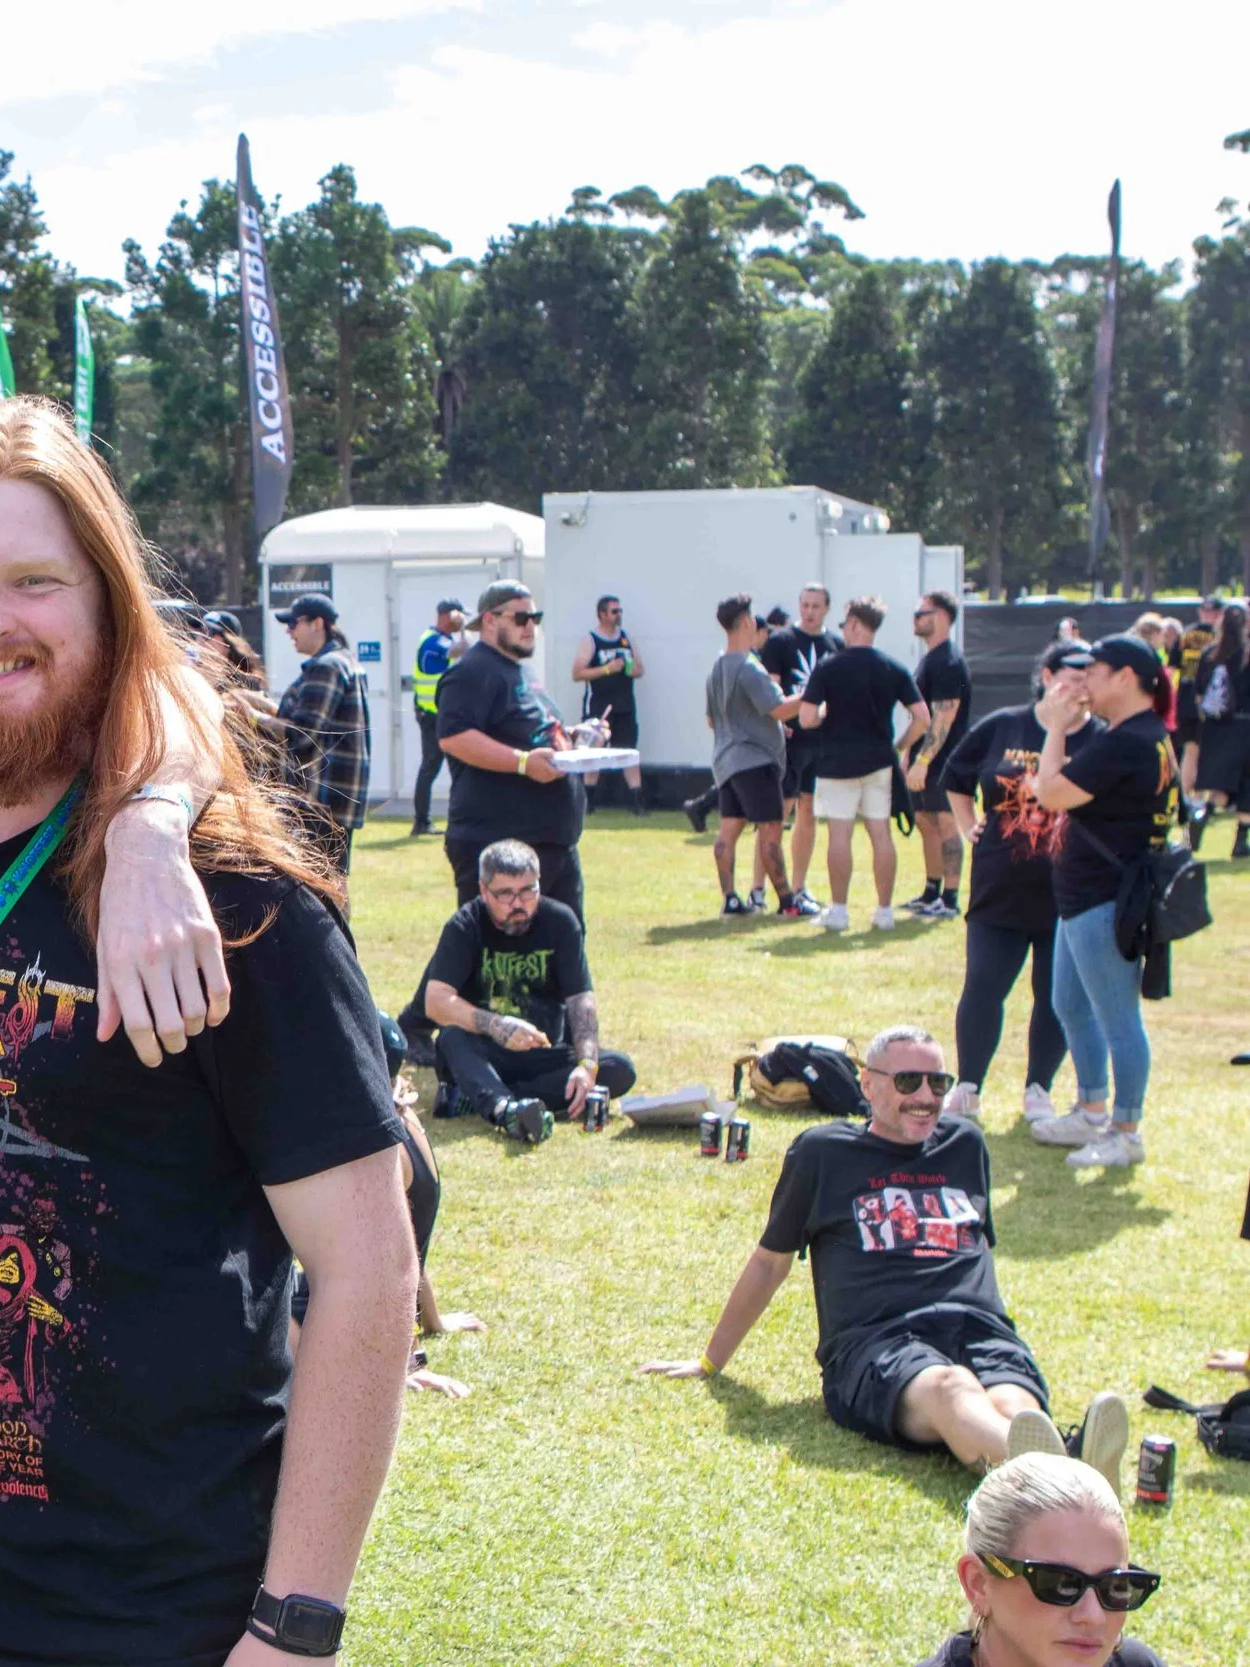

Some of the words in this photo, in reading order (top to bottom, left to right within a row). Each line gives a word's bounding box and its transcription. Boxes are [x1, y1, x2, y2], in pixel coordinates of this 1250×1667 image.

[240, 200, 286, 464] ACCESSIBLE
[270, 580, 330, 591] ACCESSIBLE
[25, 1455, 43, 1466] OF
[10, 1462, 44, 1477] YEAR
